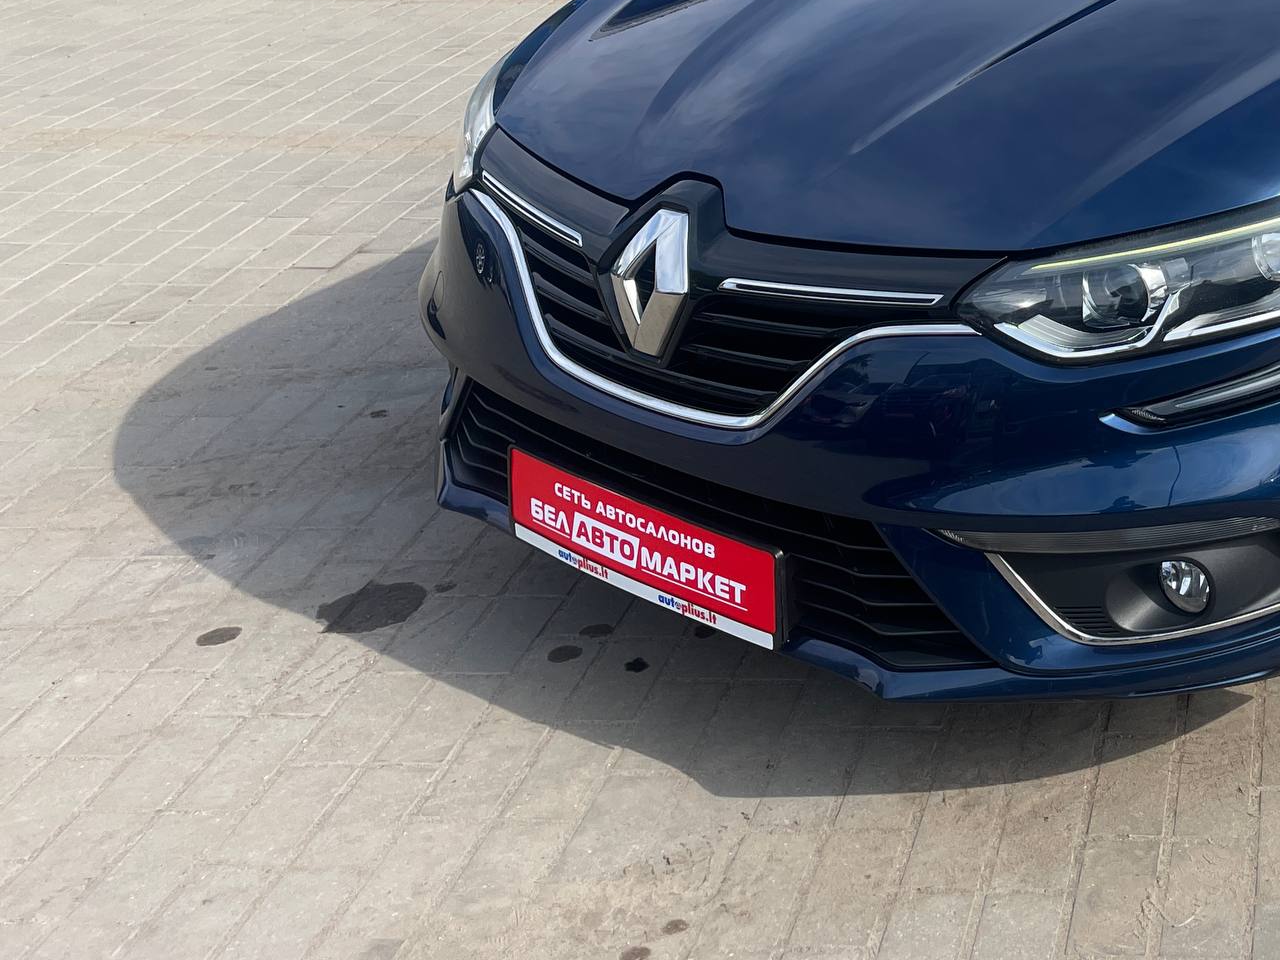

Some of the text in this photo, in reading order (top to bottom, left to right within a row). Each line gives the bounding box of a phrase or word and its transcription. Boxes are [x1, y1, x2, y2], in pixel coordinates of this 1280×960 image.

[530, 497, 747, 604] БЕЛ АВТО МАРКЕТ
[554, 482, 716, 559] СЕТЬ АВТОСАЛОНОВ
